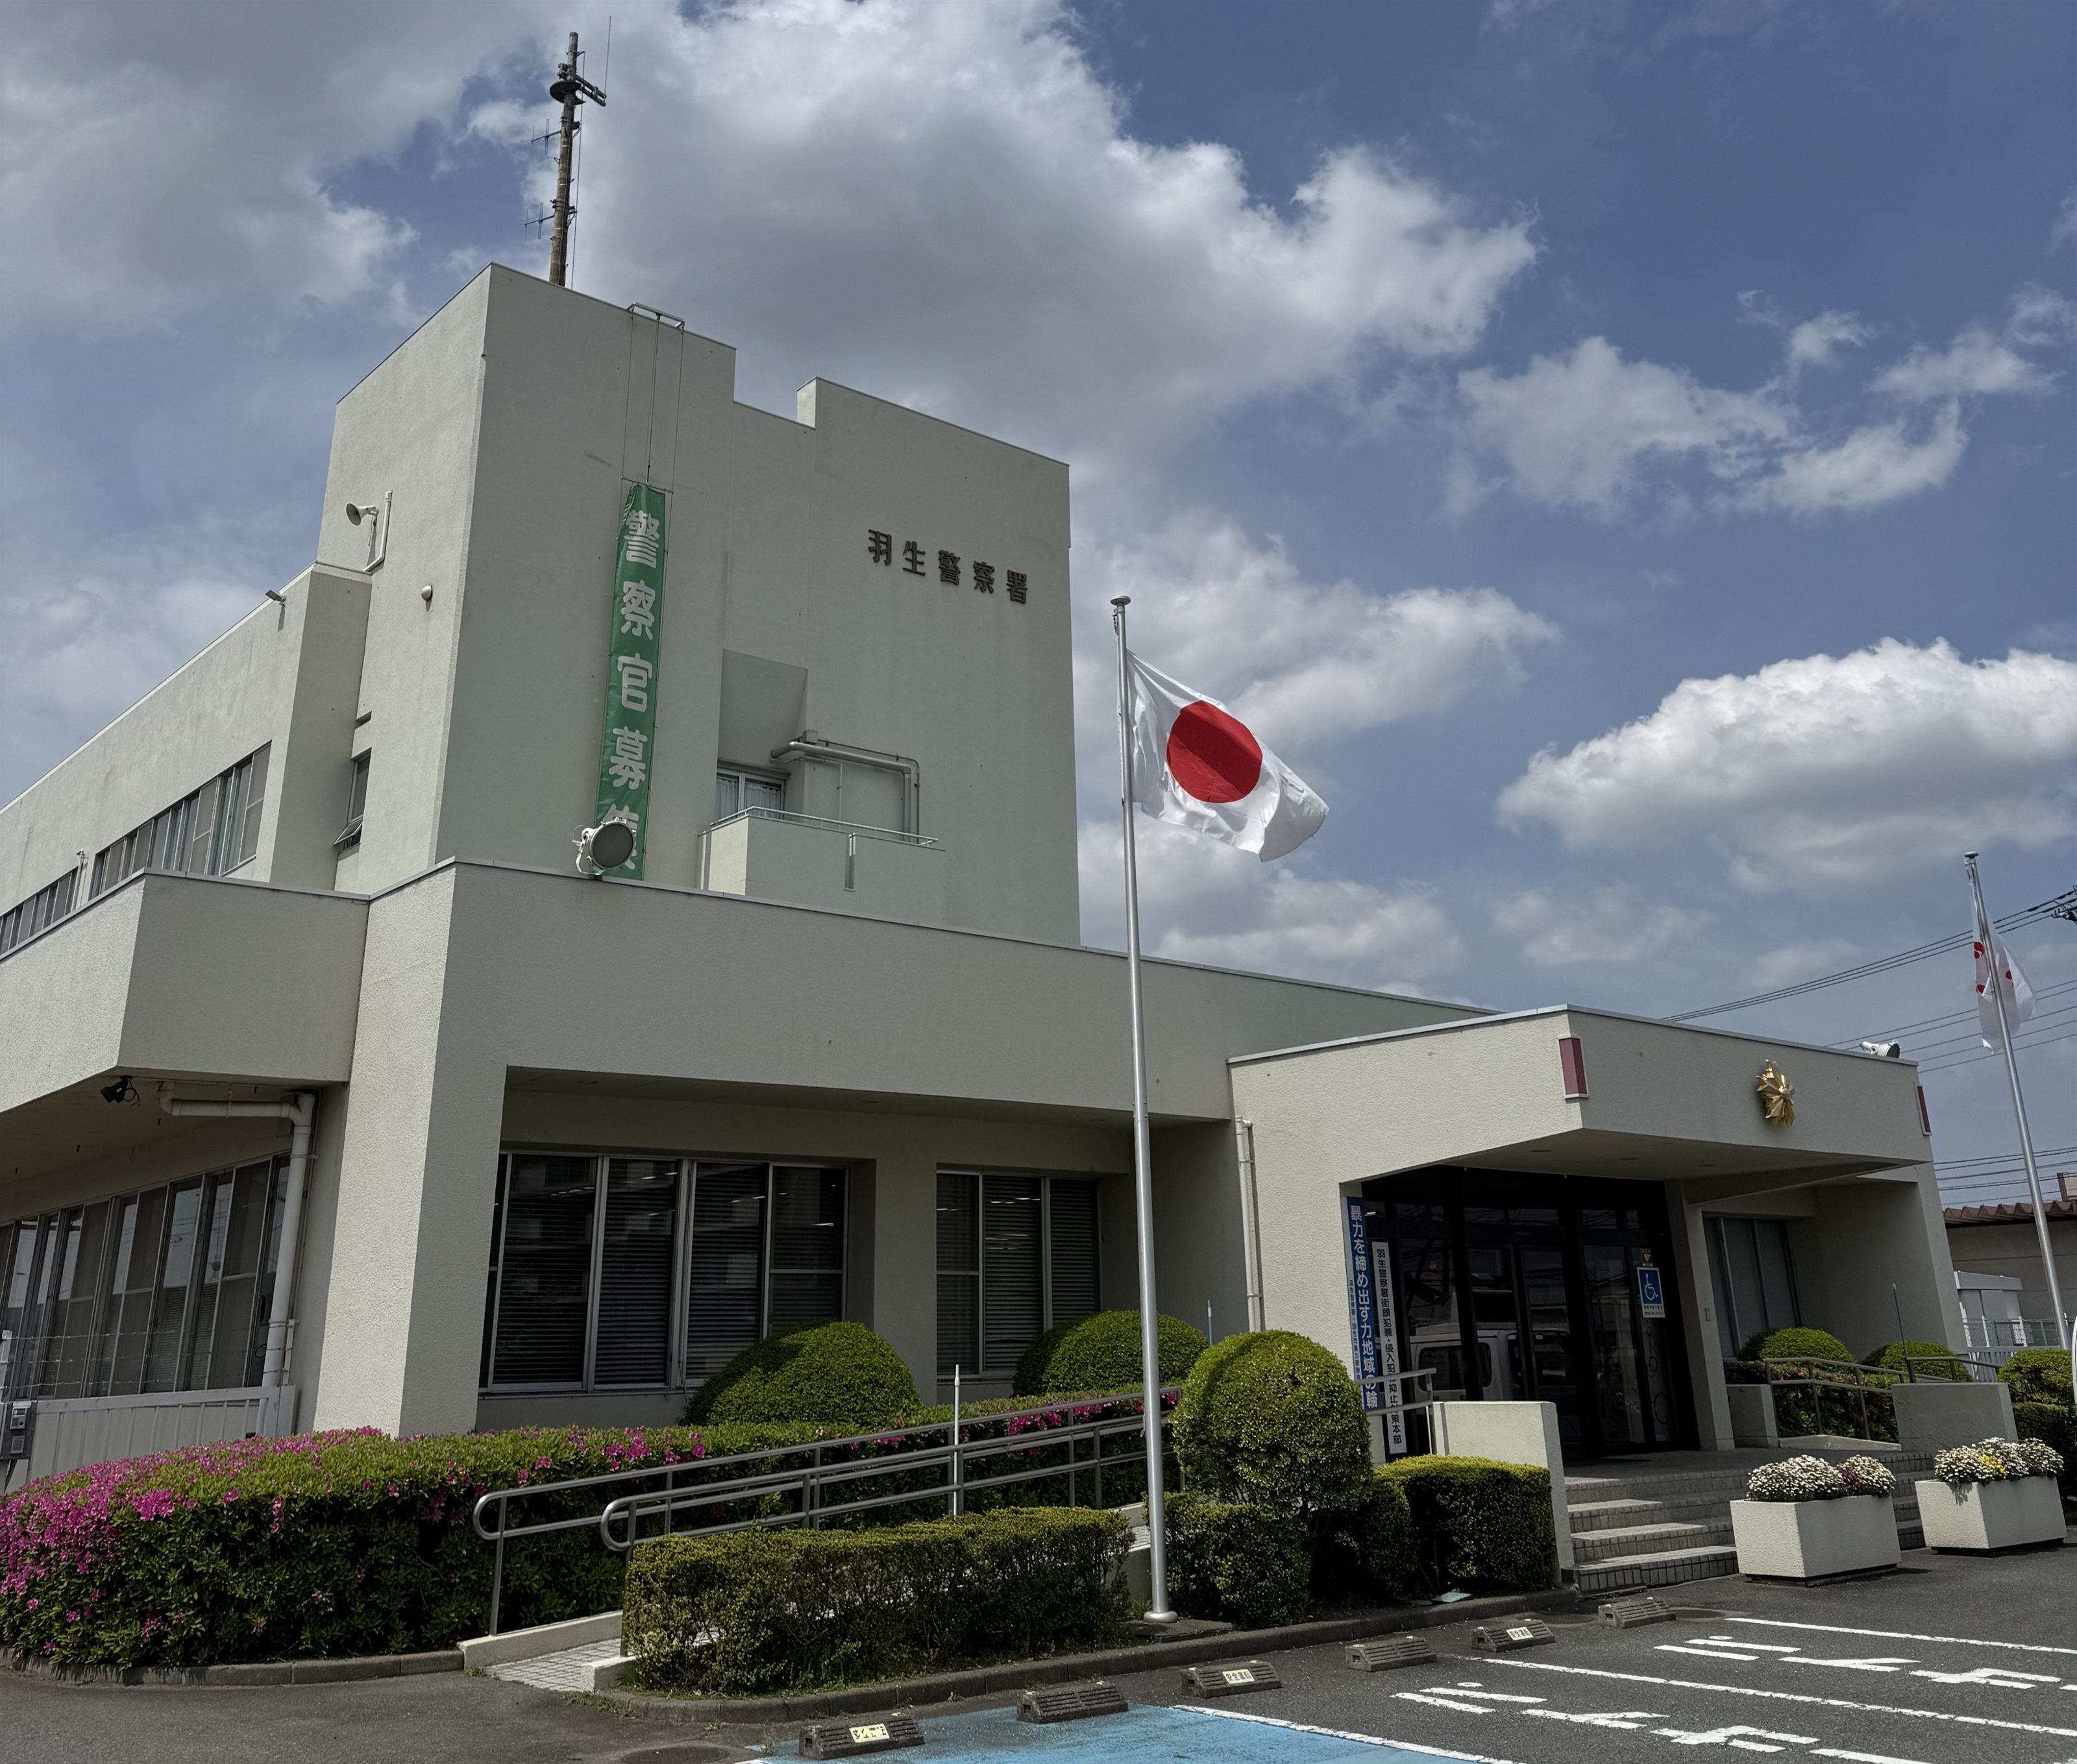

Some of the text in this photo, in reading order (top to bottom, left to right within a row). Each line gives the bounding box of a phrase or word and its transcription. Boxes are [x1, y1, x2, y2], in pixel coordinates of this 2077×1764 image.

[868, 529, 1027, 604] 羽生警察署
[1653, 1635, 2077, 1691] パトカ
